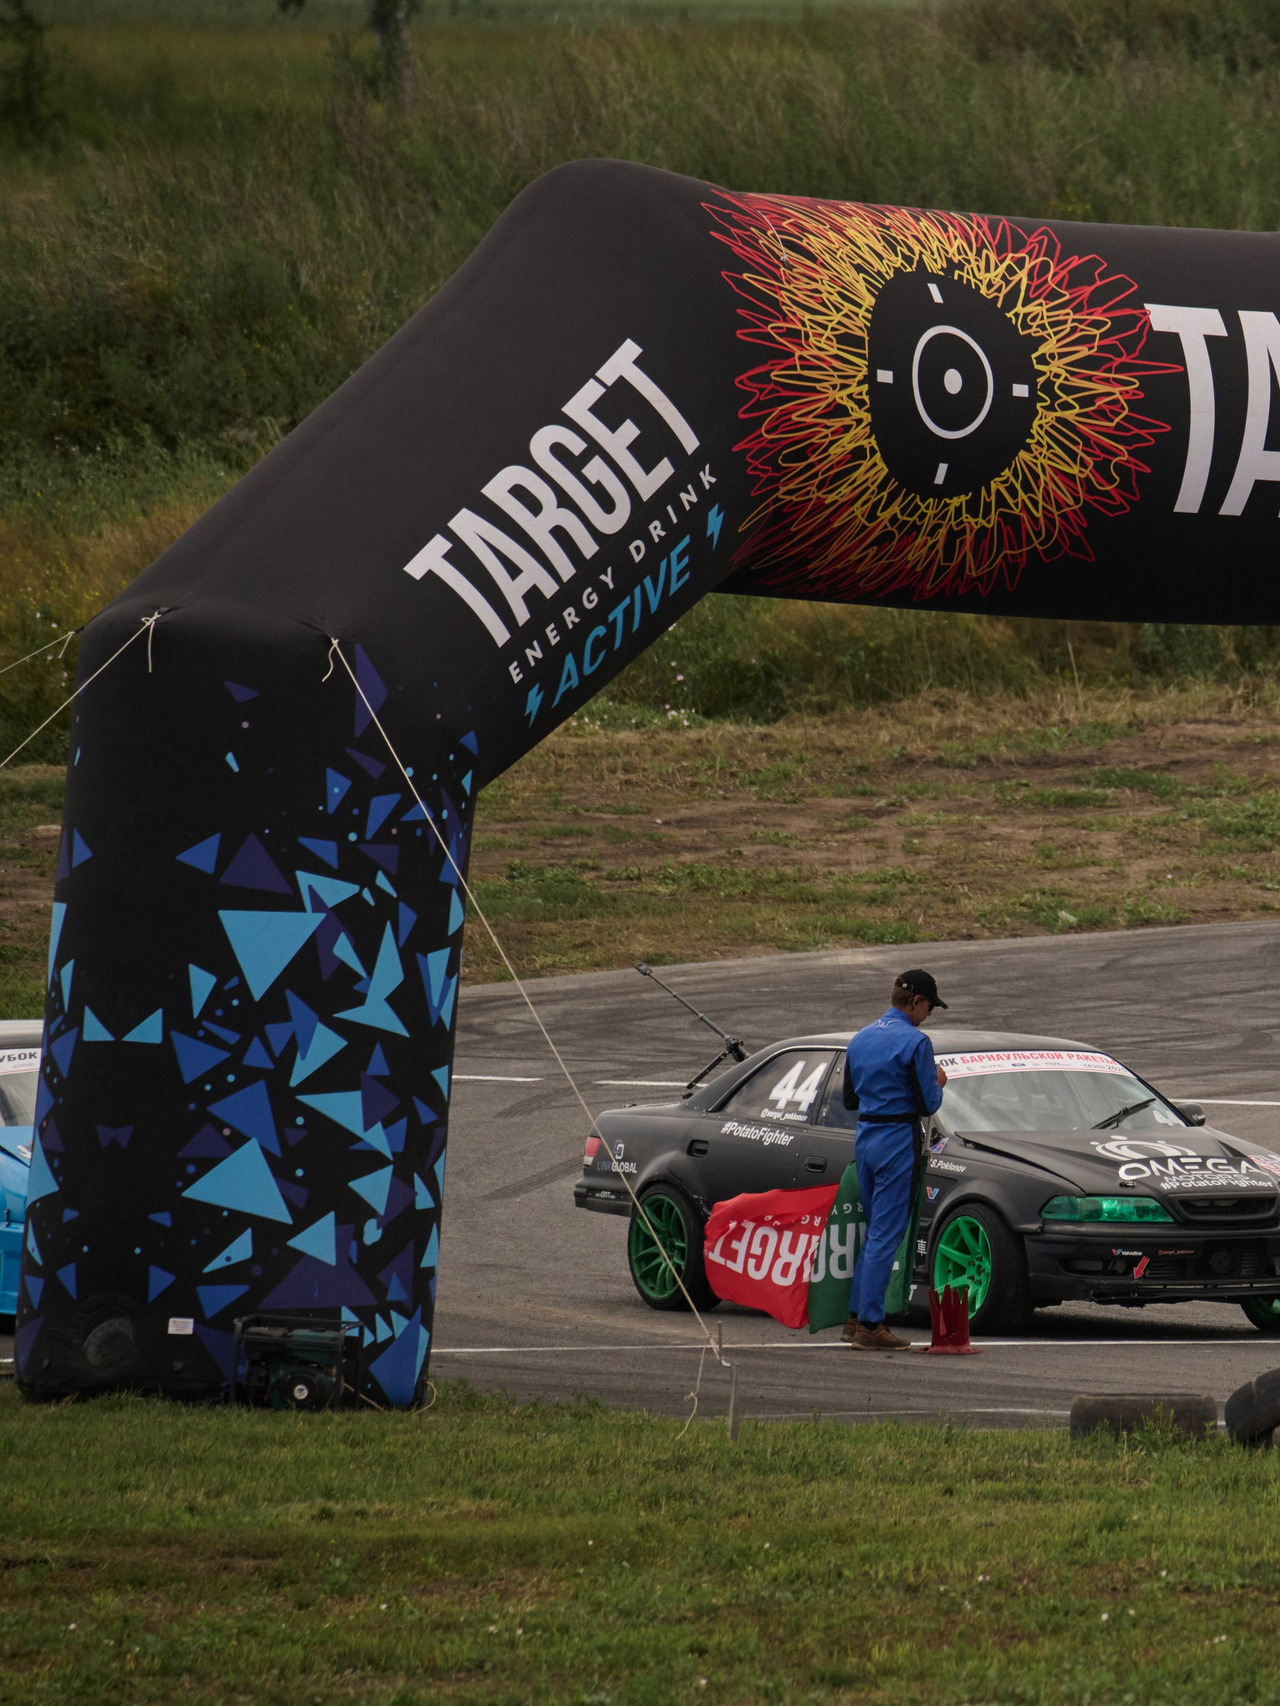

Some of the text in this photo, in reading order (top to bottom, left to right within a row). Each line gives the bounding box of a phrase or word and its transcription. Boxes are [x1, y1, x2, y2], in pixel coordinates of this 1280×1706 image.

[403, 338, 700, 648] TARGET
[508, 463, 717, 684] ENERGY DRINK
[551, 534, 690, 708] ACTIVE
[960, 1051, 1064, 1065] БАРНАУЛЬСКОЙ
[1065, 1053, 1118, 1066] РАКЕТЫ
[769, 1060, 828, 1112] 44
[721, 1121, 794, 1146] #PotatoFighter
[1118, 1158, 1270, 1181] OMEGA
[1163, 1174, 1251, 1183] MOTORS
[1160, 1178, 1274, 1190] #PotatoFighter
